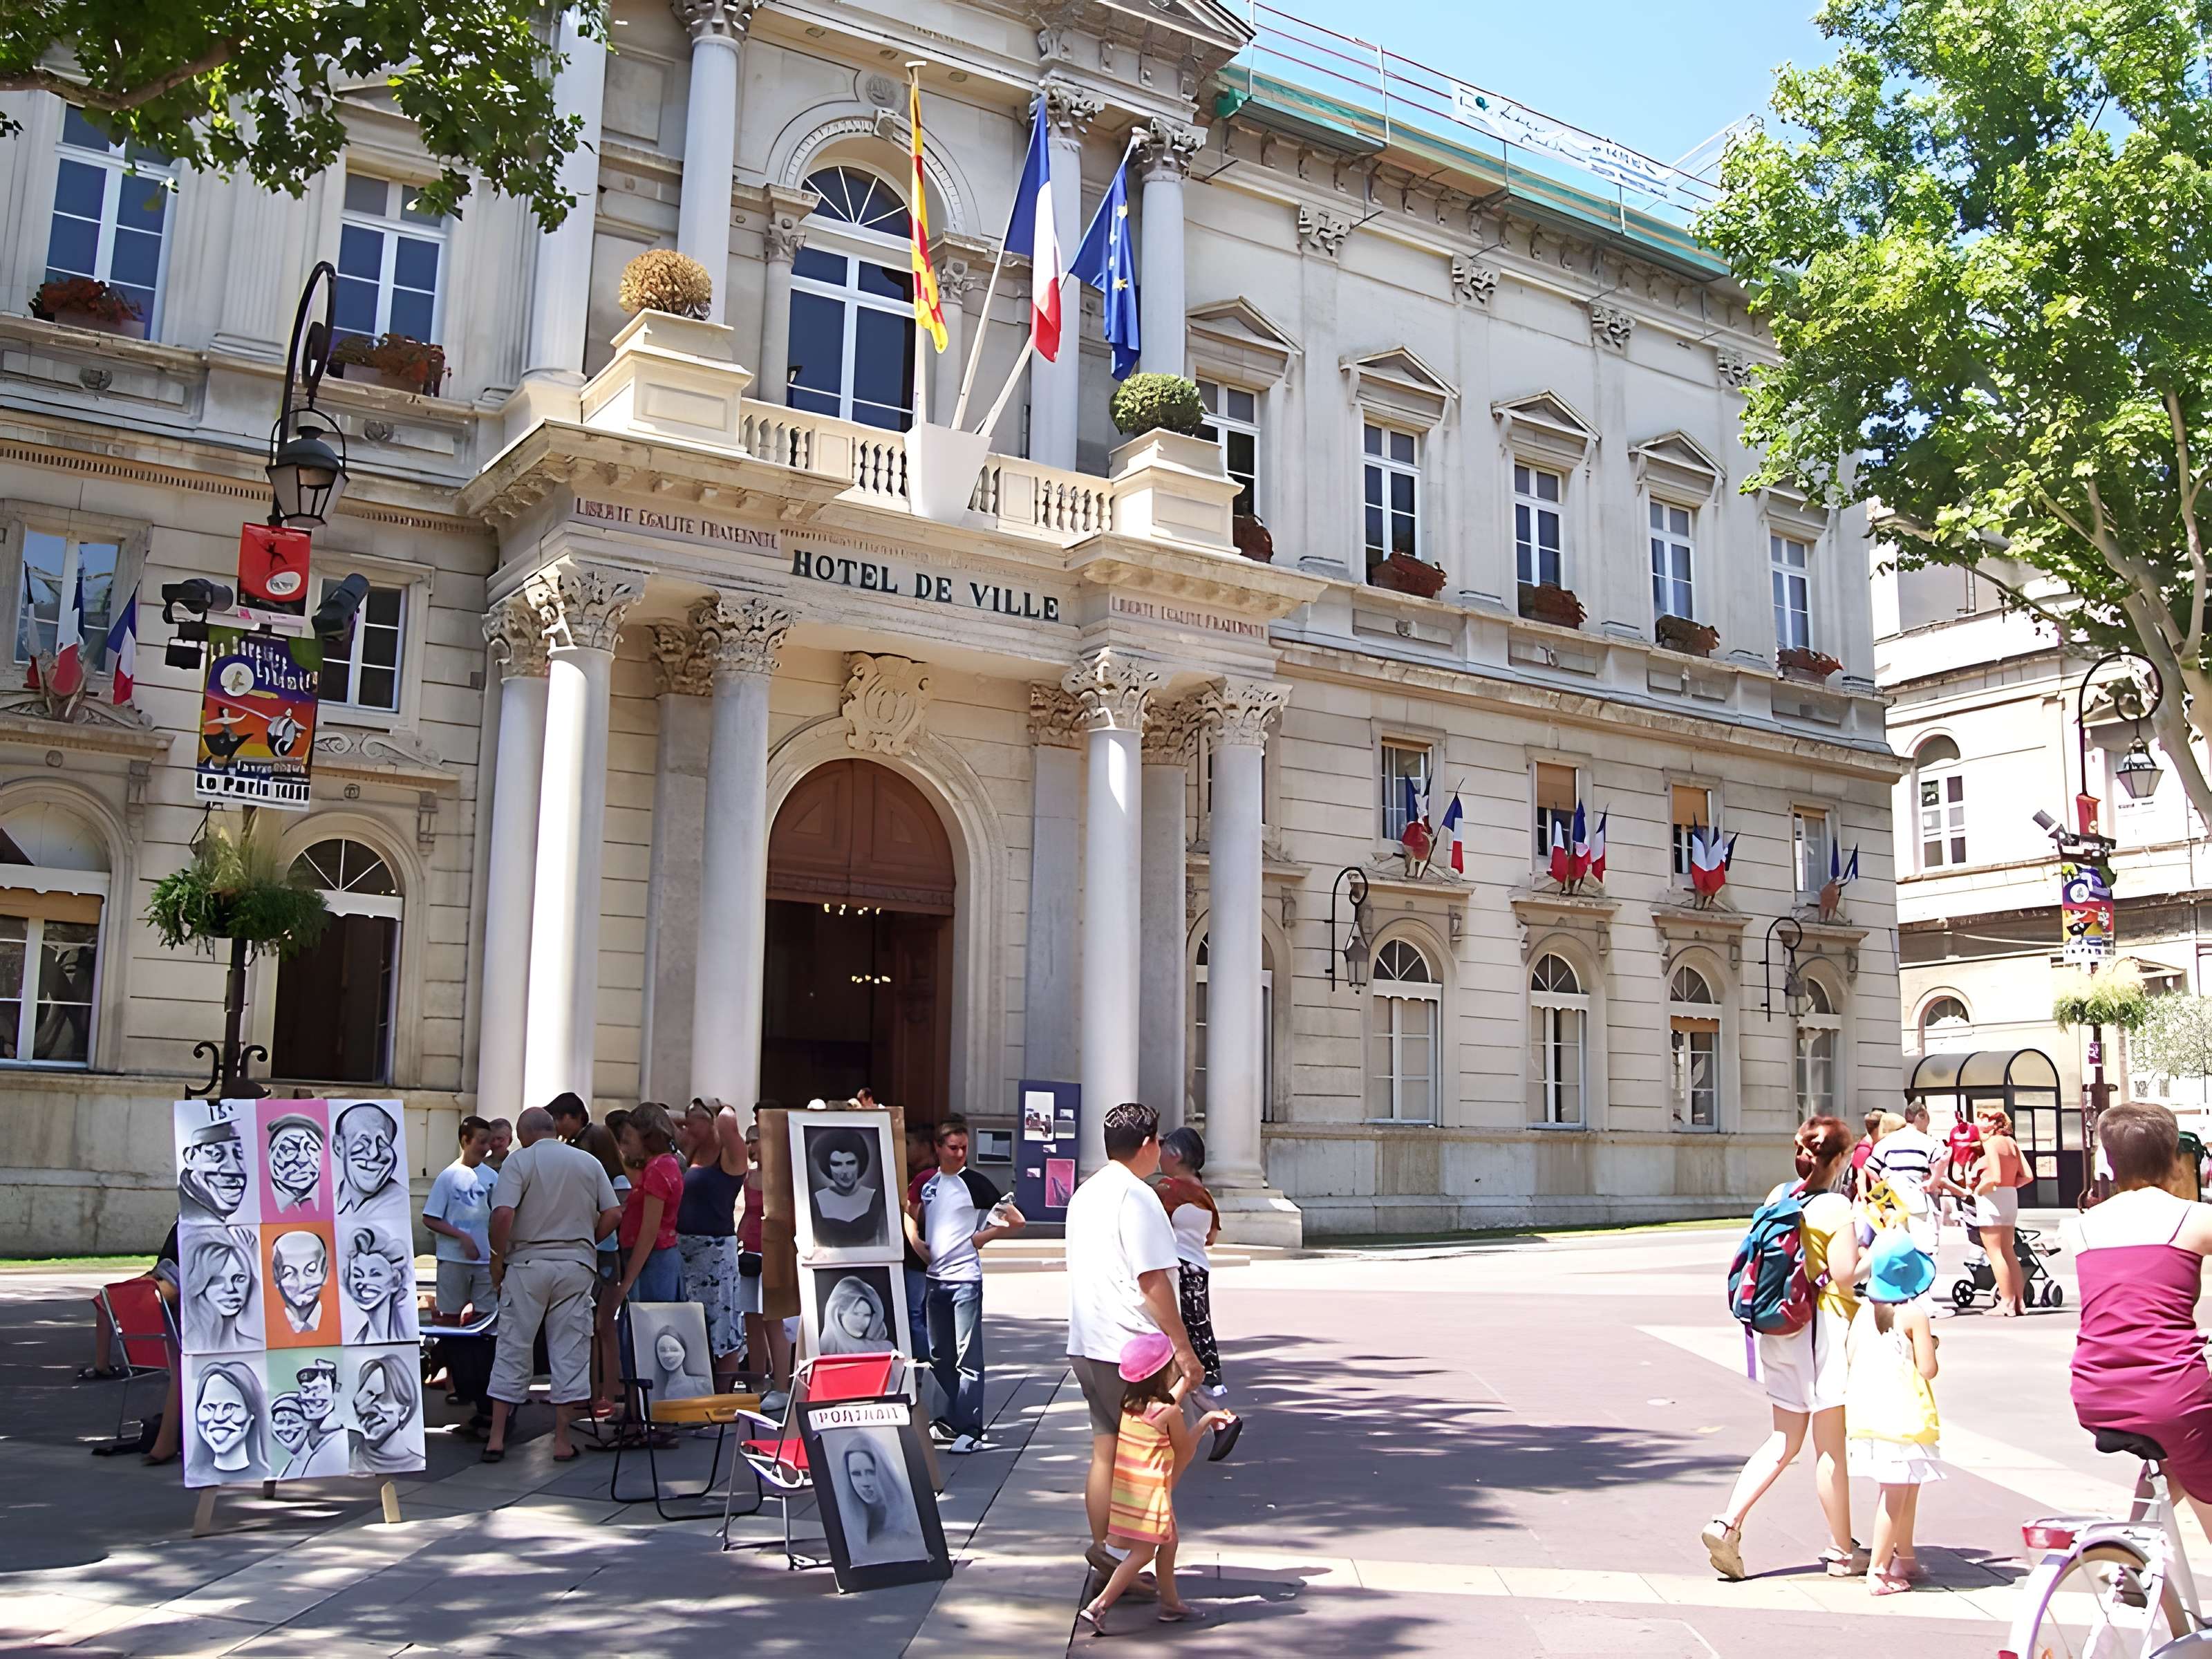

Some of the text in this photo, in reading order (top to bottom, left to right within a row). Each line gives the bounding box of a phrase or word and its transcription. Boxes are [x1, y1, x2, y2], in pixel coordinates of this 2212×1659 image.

[791, 549, 1059, 621] HOTEL DE VILLE
